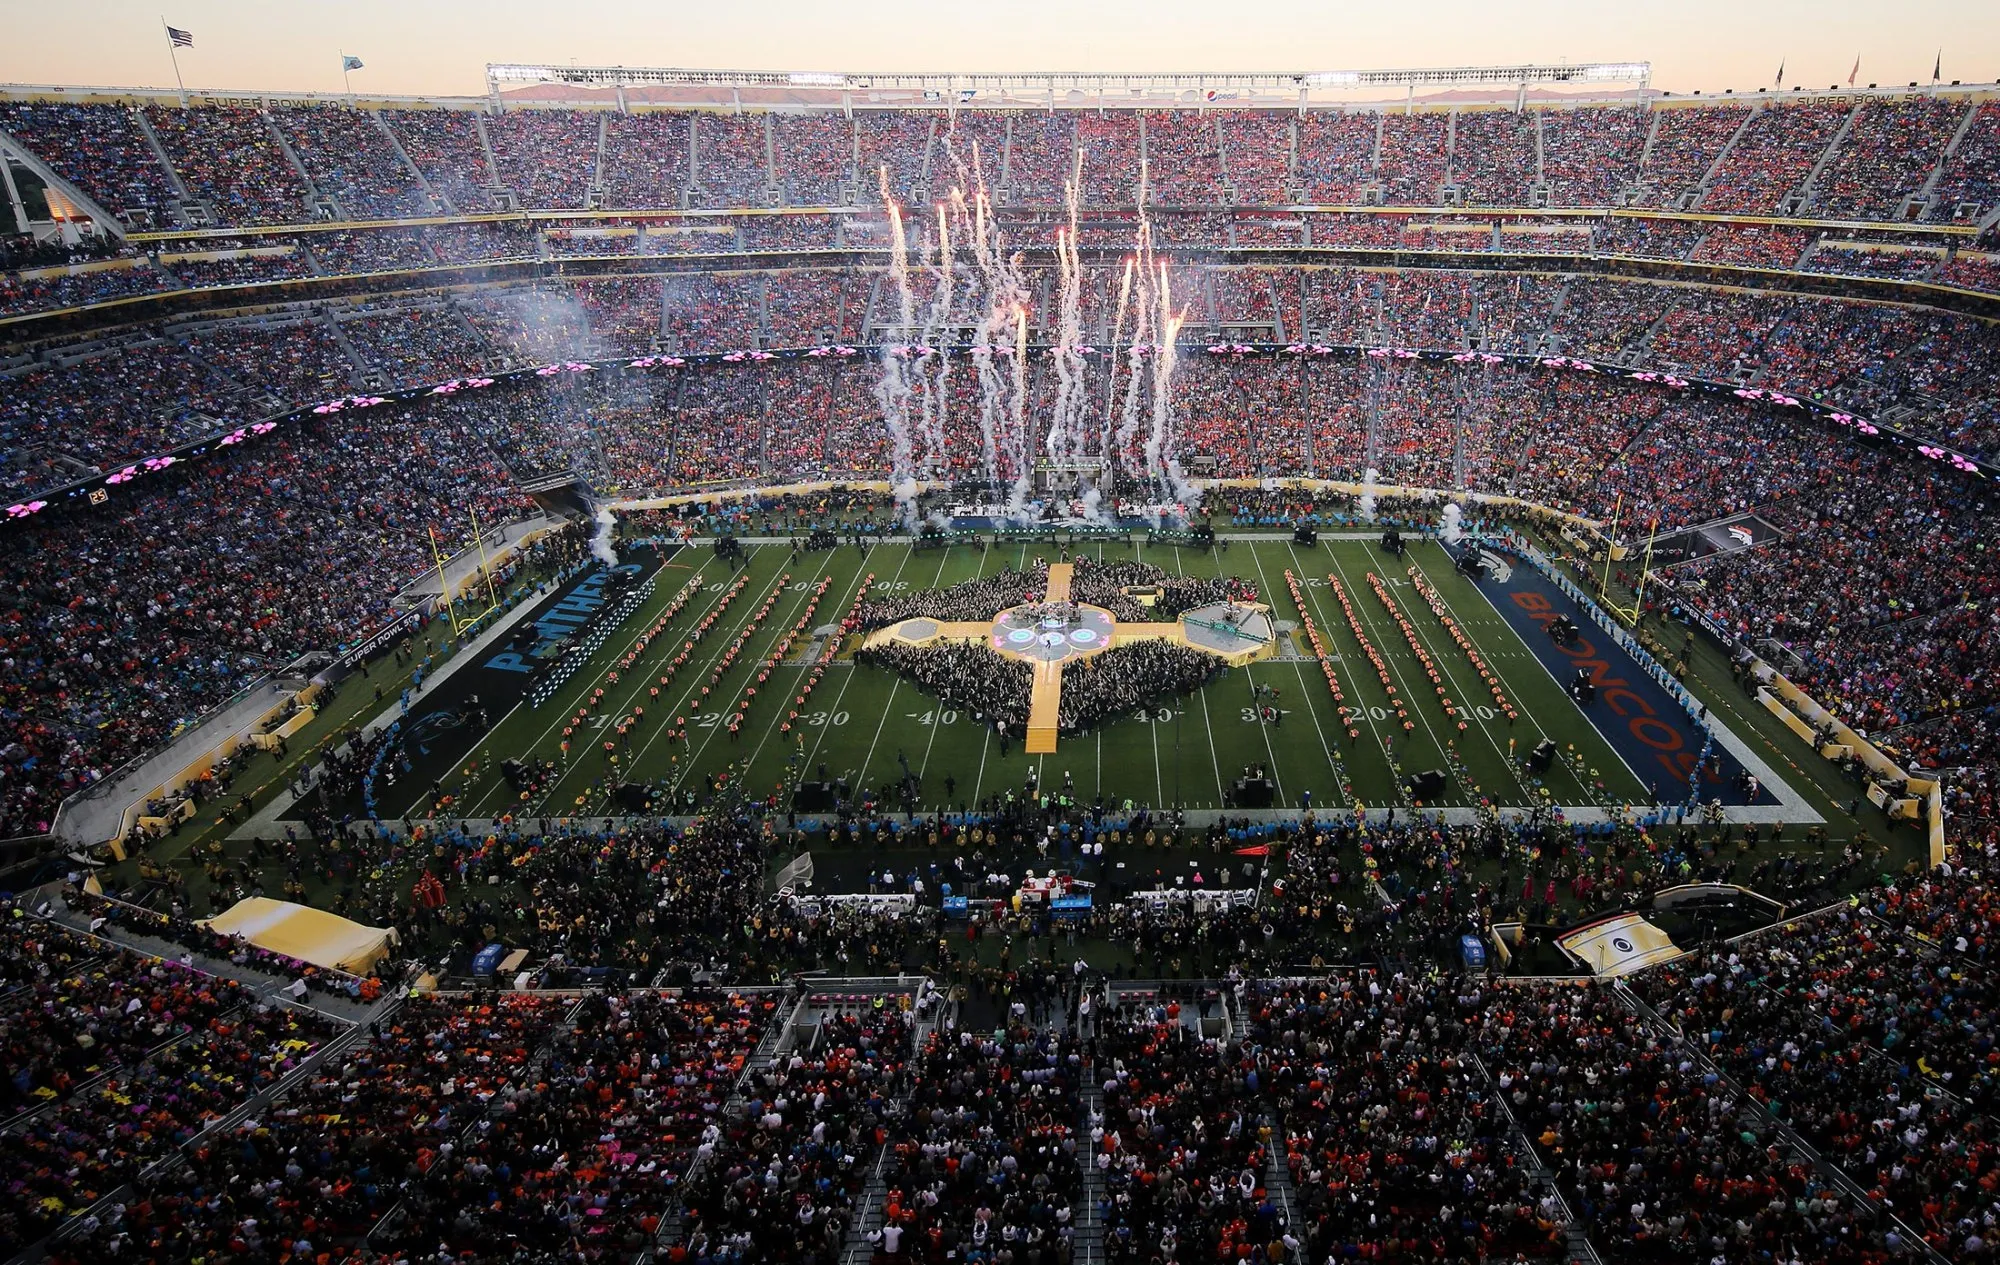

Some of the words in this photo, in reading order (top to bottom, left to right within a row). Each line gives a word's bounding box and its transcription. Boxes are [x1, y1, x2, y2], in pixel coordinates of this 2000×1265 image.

[204, 97, 263, 109] SUPER
[269, 99, 317, 109] BOWL
[320, 100, 340, 109] 50
[1217, 92, 1238, 101] pepsi
[1797, 96, 1847, 106] SUPER
[1854, 95, 1894, 104] BOWL
[1904, 93, 1925, 103] 50
[92, 490, 106, 502] 25
[878, 581, 909, 591] 30
[1700, 618, 1722, 639] BOWL
[1721, 635, 1733, 647] 50
[344, 643, 378, 668] SUPER
[404, 616, 416, 628] 50
[698, 712, 740, 727] 20
[808, 711, 850, 726] 30
[917, 710, 958, 725] 40
[1133, 708, 1173, 723] 40
[1241, 706, 1279, 723] 30
[1348, 706, 1388, 721] 20
[1455, 704, 1494, 721] 10
[590, 712, 631, 729] 10
